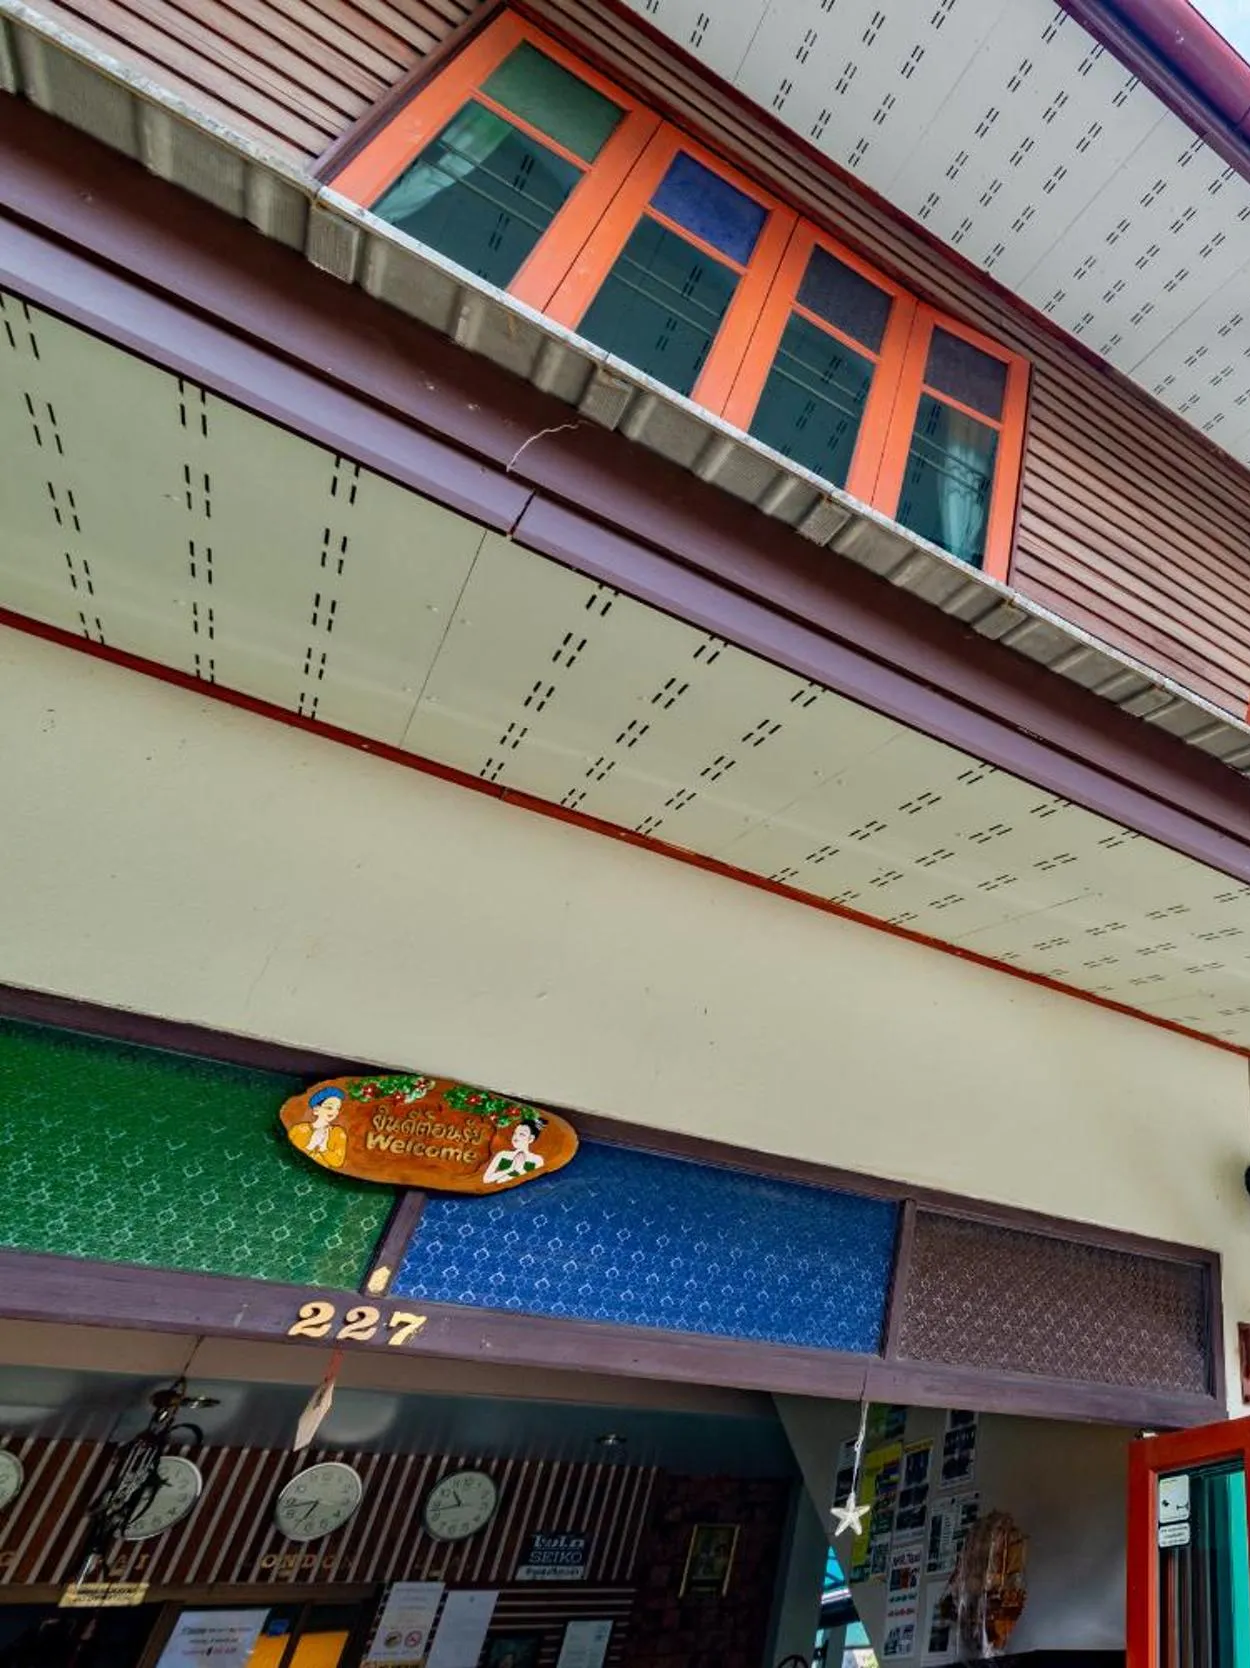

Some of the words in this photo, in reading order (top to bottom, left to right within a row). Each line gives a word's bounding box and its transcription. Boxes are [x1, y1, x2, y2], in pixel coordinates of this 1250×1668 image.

[365, 1131, 479, 1164] Welcome
[287, 1301, 427, 1345] 227
[528, 1550, 583, 1564] SEIKO
